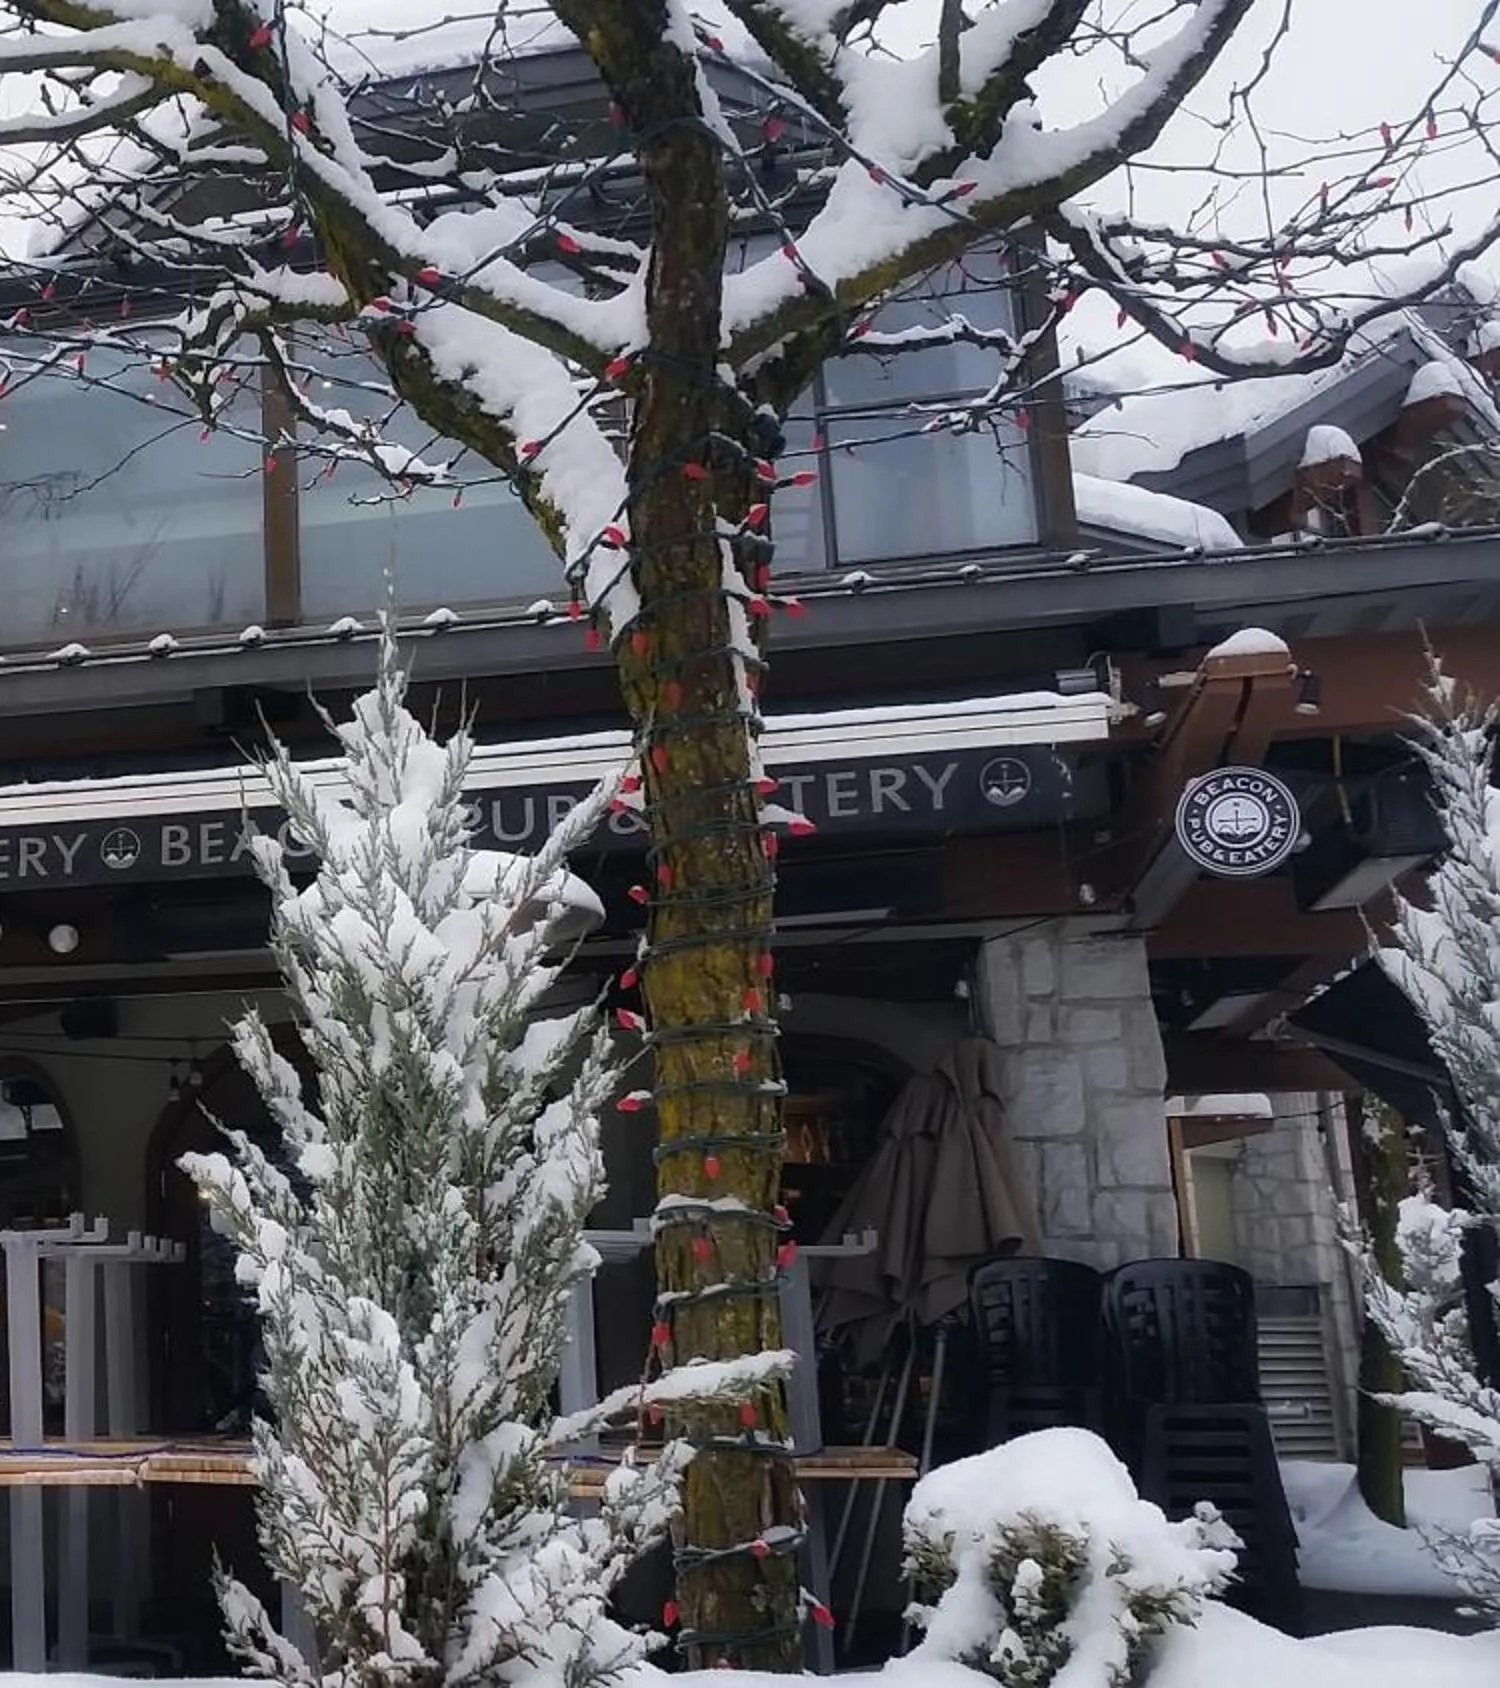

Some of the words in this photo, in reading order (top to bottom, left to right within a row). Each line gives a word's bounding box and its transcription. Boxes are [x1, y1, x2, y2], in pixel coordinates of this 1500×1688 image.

[160, 818, 322, 867] BEAC
[779, 763, 959, 818] TERY
[1194, 777, 1279, 806] BEACON
